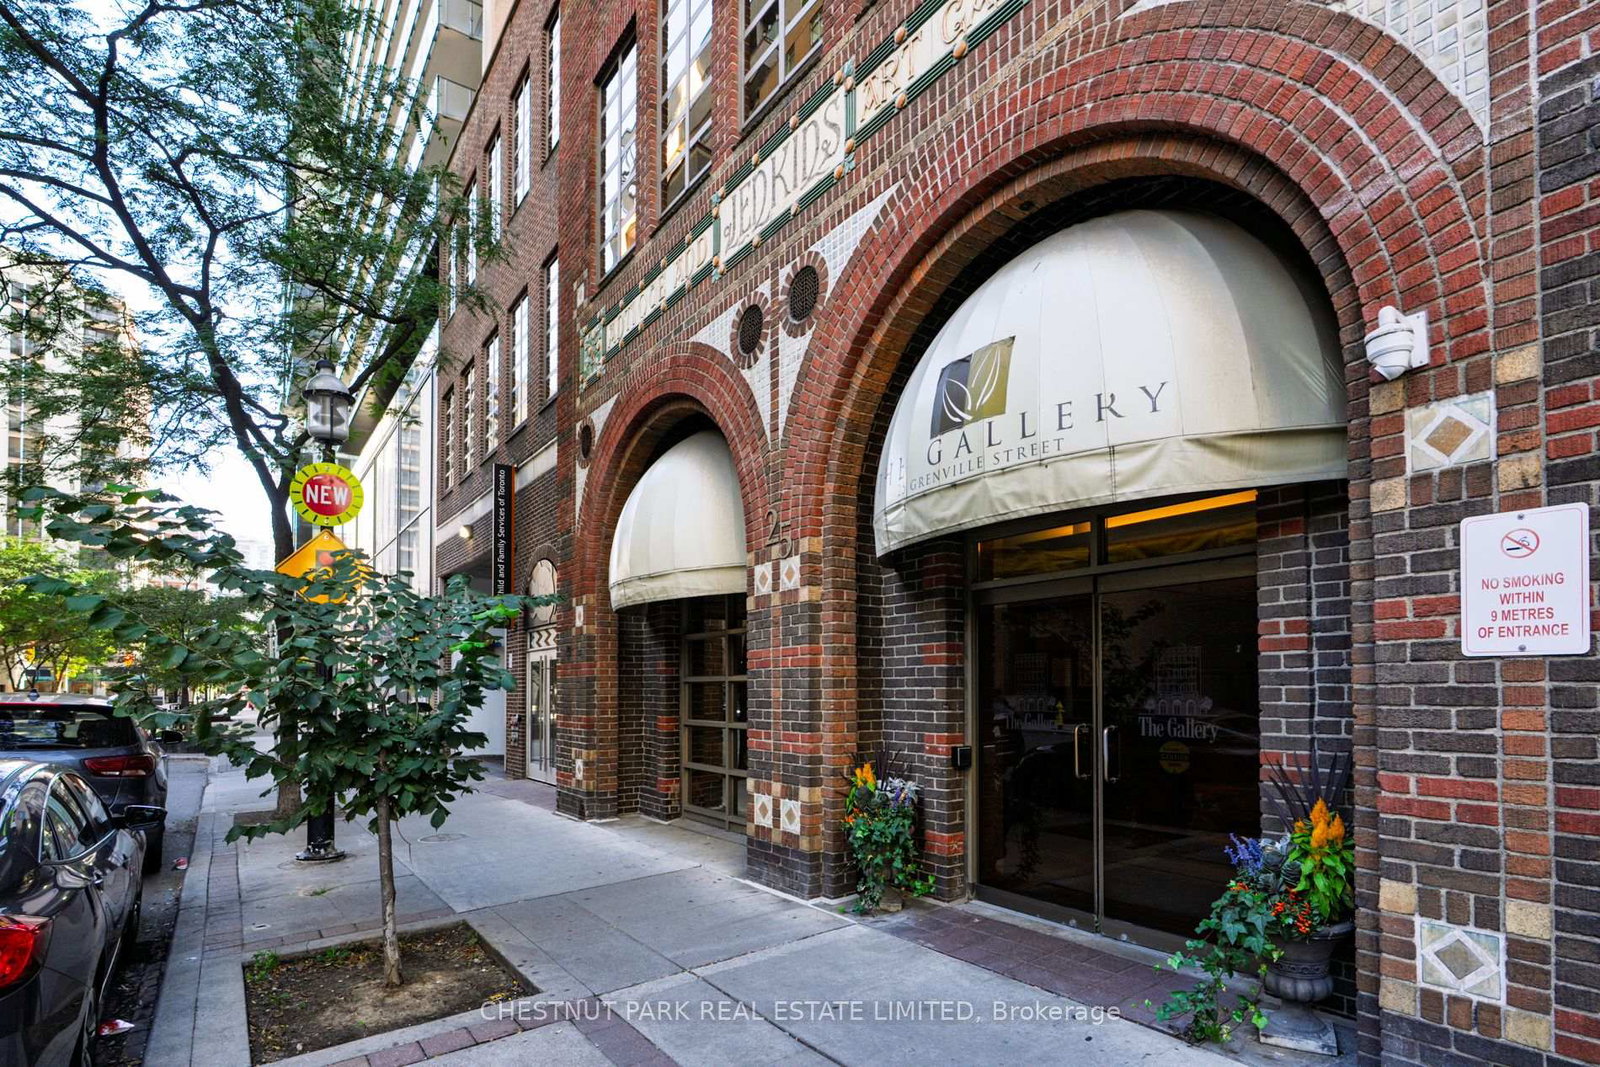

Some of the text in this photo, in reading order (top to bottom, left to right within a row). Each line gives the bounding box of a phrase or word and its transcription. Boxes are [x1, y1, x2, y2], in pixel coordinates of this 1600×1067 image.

[860, 30, 923, 123] ART
[927, 381, 1169, 466] GALLERY
[909, 455, 984, 491] GRENVILLE
[992, 437, 1064, 466] STREET
[306, 484, 348, 505] NEW
[498, 469, 506, 496] Toronto
[497, 496, 505, 506] of
[498, 507, 506, 538] Services
[764, 508, 793, 559] 25
[497, 539, 507, 563] Family
[497, 580, 505, 595] hild
[1481, 572, 1565, 590] NO SMOKING
[1499, 591, 1545, 605] WITHIN
[1490, 607, 1554, 622] 9 METRES
[1477, 623, 1569, 639] OF ENTRANCE
[1138, 716, 1218, 743] The Gallery
